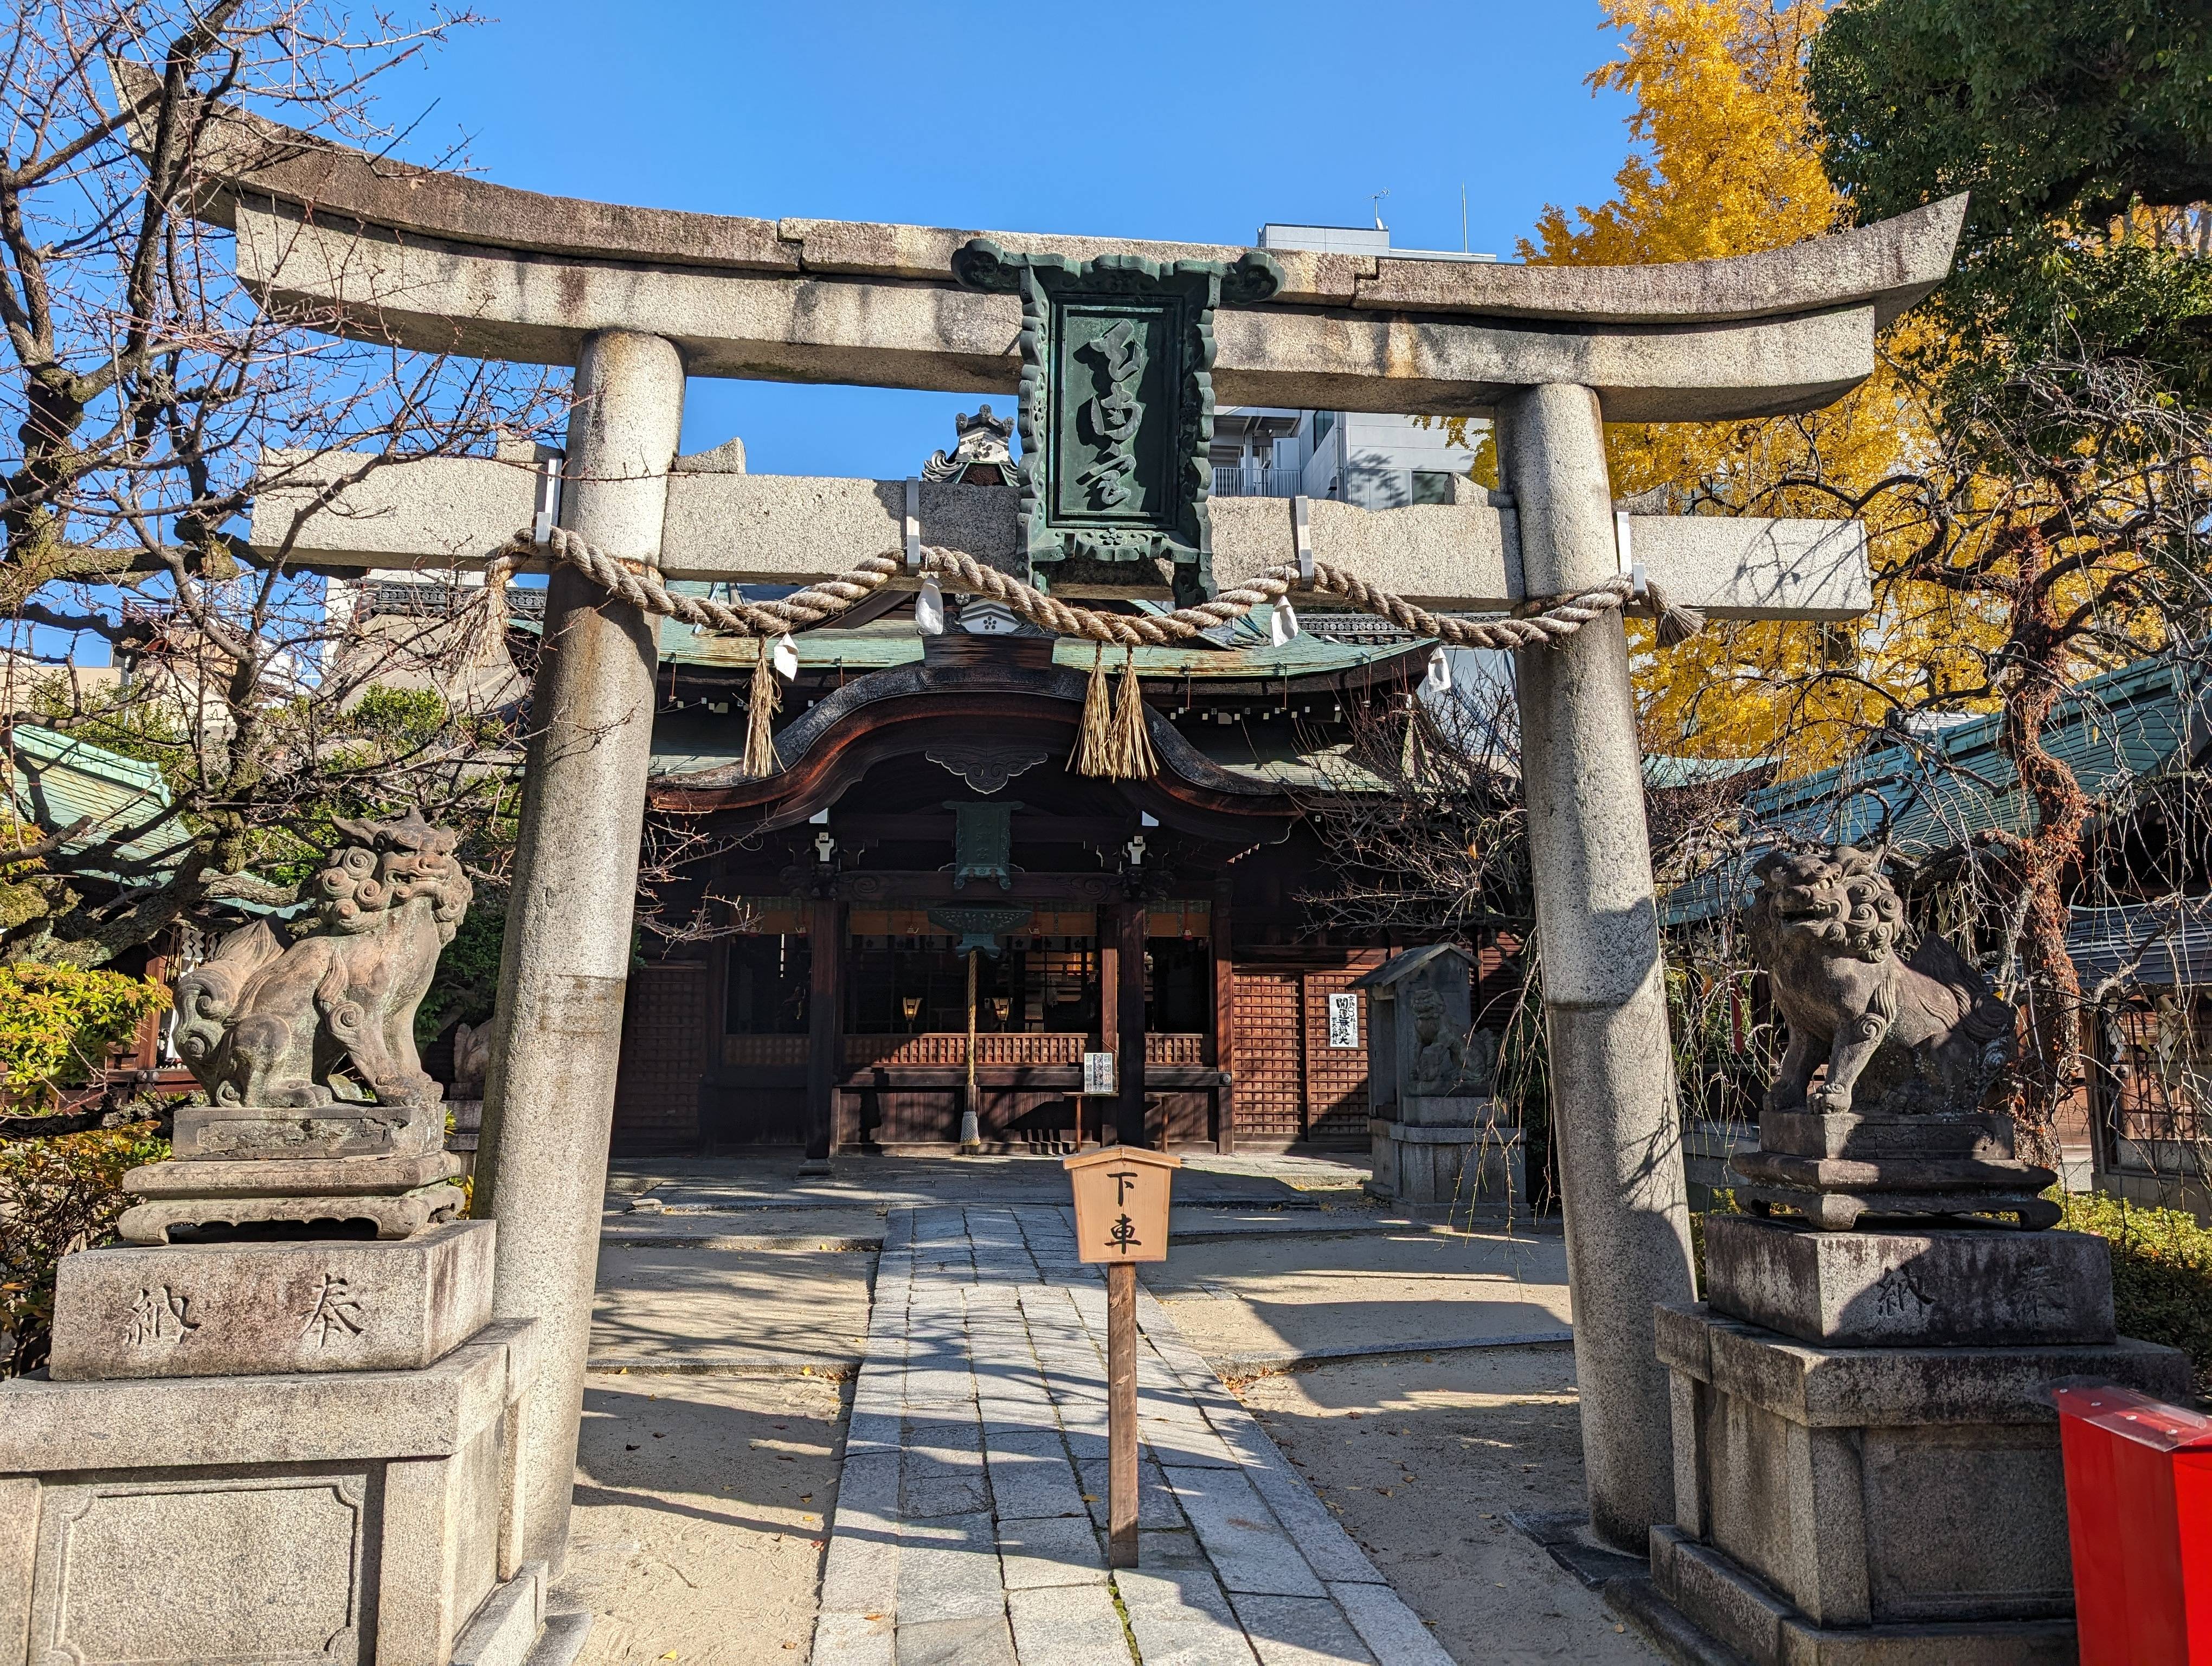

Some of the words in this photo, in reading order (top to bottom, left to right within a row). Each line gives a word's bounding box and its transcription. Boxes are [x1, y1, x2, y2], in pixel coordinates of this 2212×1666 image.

[1336, 997, 1350, 1045] 開運無限大
[1104, 1171, 1142, 1254] 下車
